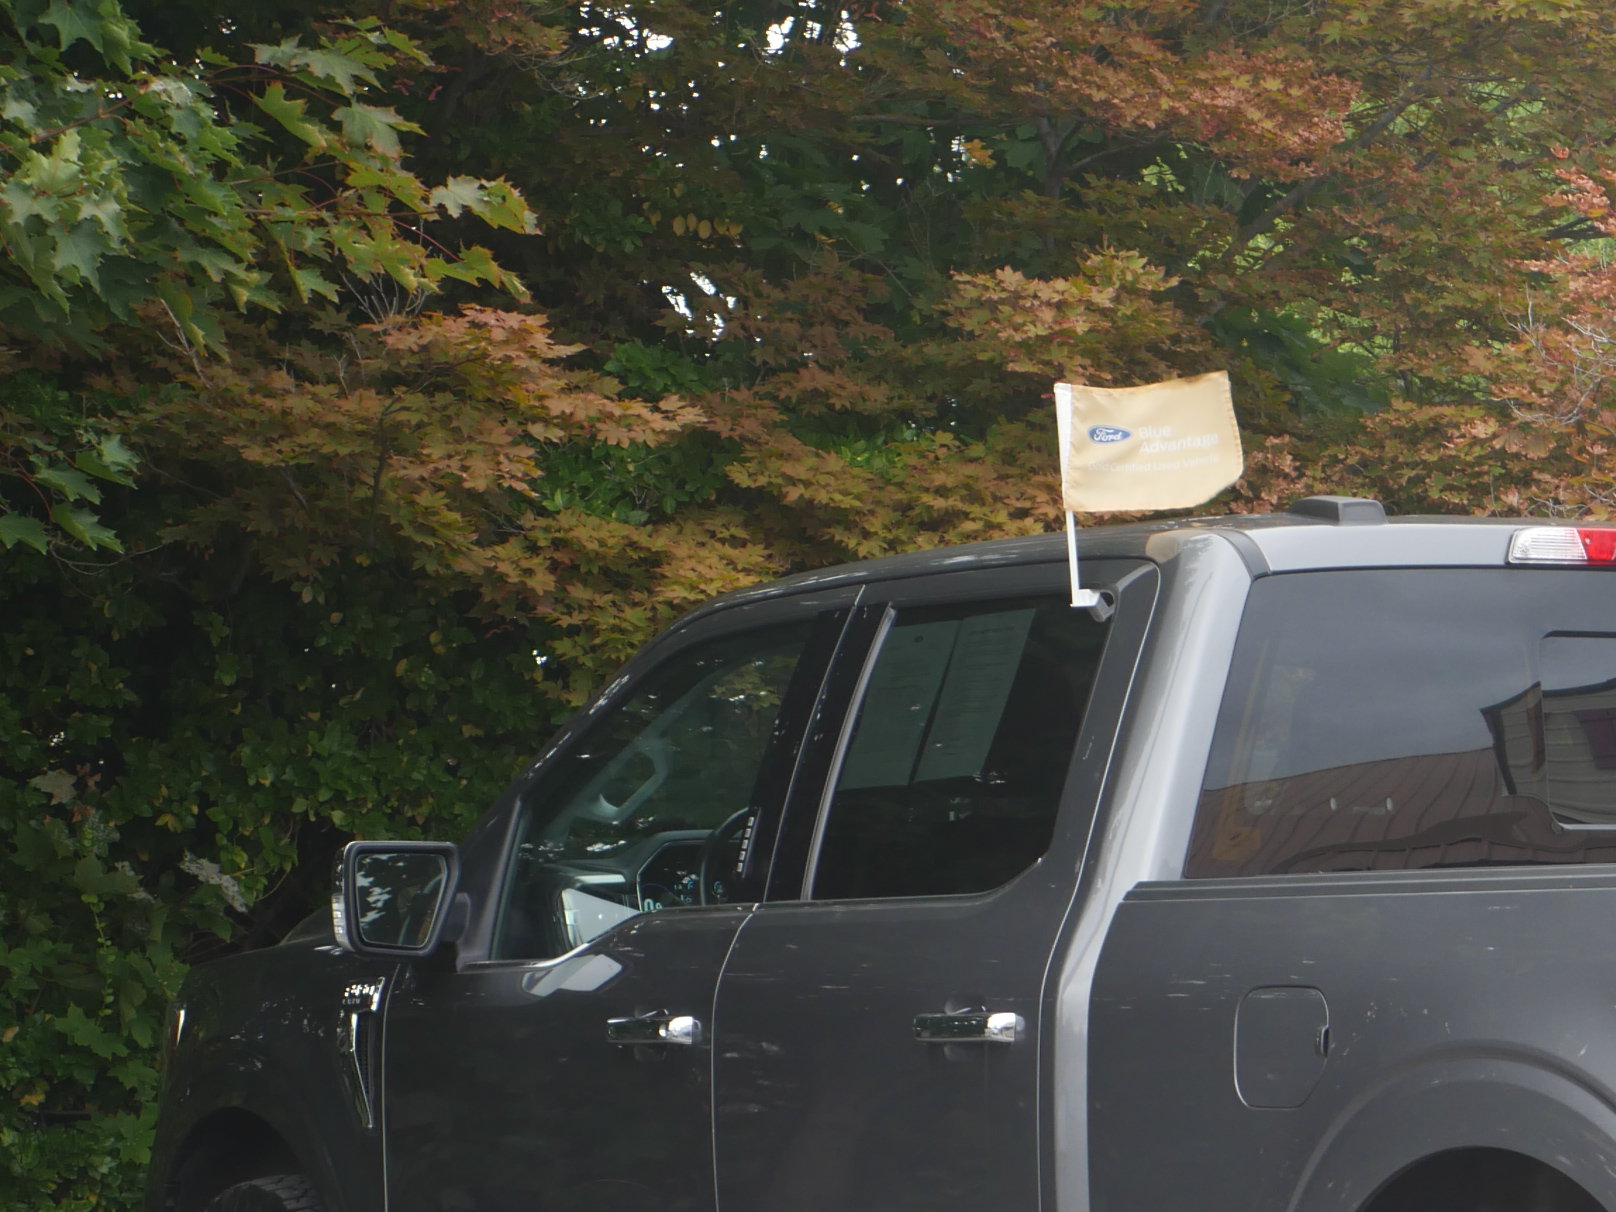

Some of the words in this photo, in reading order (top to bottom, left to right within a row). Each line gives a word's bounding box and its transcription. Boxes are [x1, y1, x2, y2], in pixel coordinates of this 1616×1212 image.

[1093, 428, 1123, 442] Ford
[1138, 425, 1173, 439] Blue
[1139, 432, 1220, 454] Advantage
